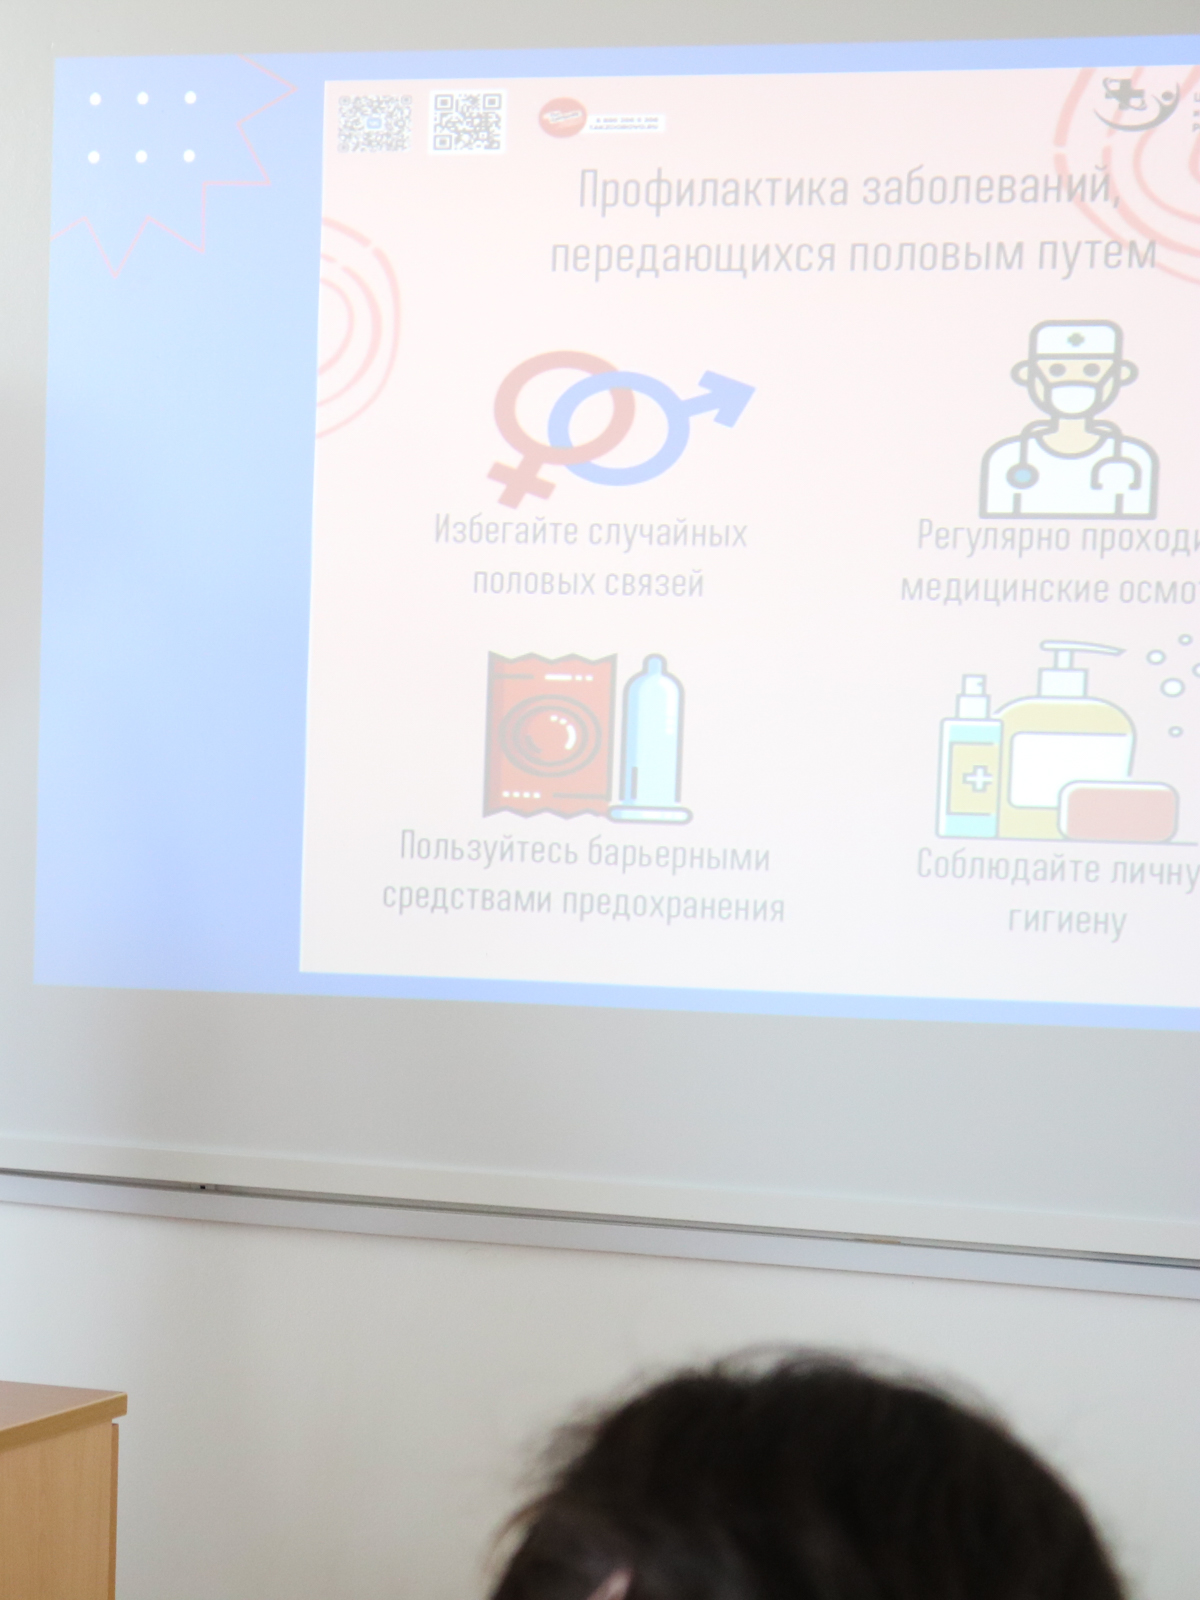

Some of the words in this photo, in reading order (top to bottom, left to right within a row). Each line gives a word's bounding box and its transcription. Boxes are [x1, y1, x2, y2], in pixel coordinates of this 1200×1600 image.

[579, 165, 848, 216] Профилактика
[863, 163, 1121, 210] заболеваний,
[552, 243, 835, 282] передающихся
[850, 241, 1024, 271] половым
[1039, 239, 1158, 280] путем
[434, 512, 577, 546] Избегайте
[589, 518, 748, 552] случайных
[918, 517, 1071, 558] Регулярно
[474, 571, 596, 596] половых
[605, 569, 704, 598] связей
[901, 578, 1109, 607] медицинские
[1119, 579, 1200, 605] осмо
[401, 829, 578, 869] Пользуйтесь
[588, 834, 770, 875] барьерными
[917, 847, 1100, 886] Соблюдайте
[383, 886, 552, 915] средствами
[563, 892, 785, 925] предохранения
[1009, 909, 1128, 943] гигиену
